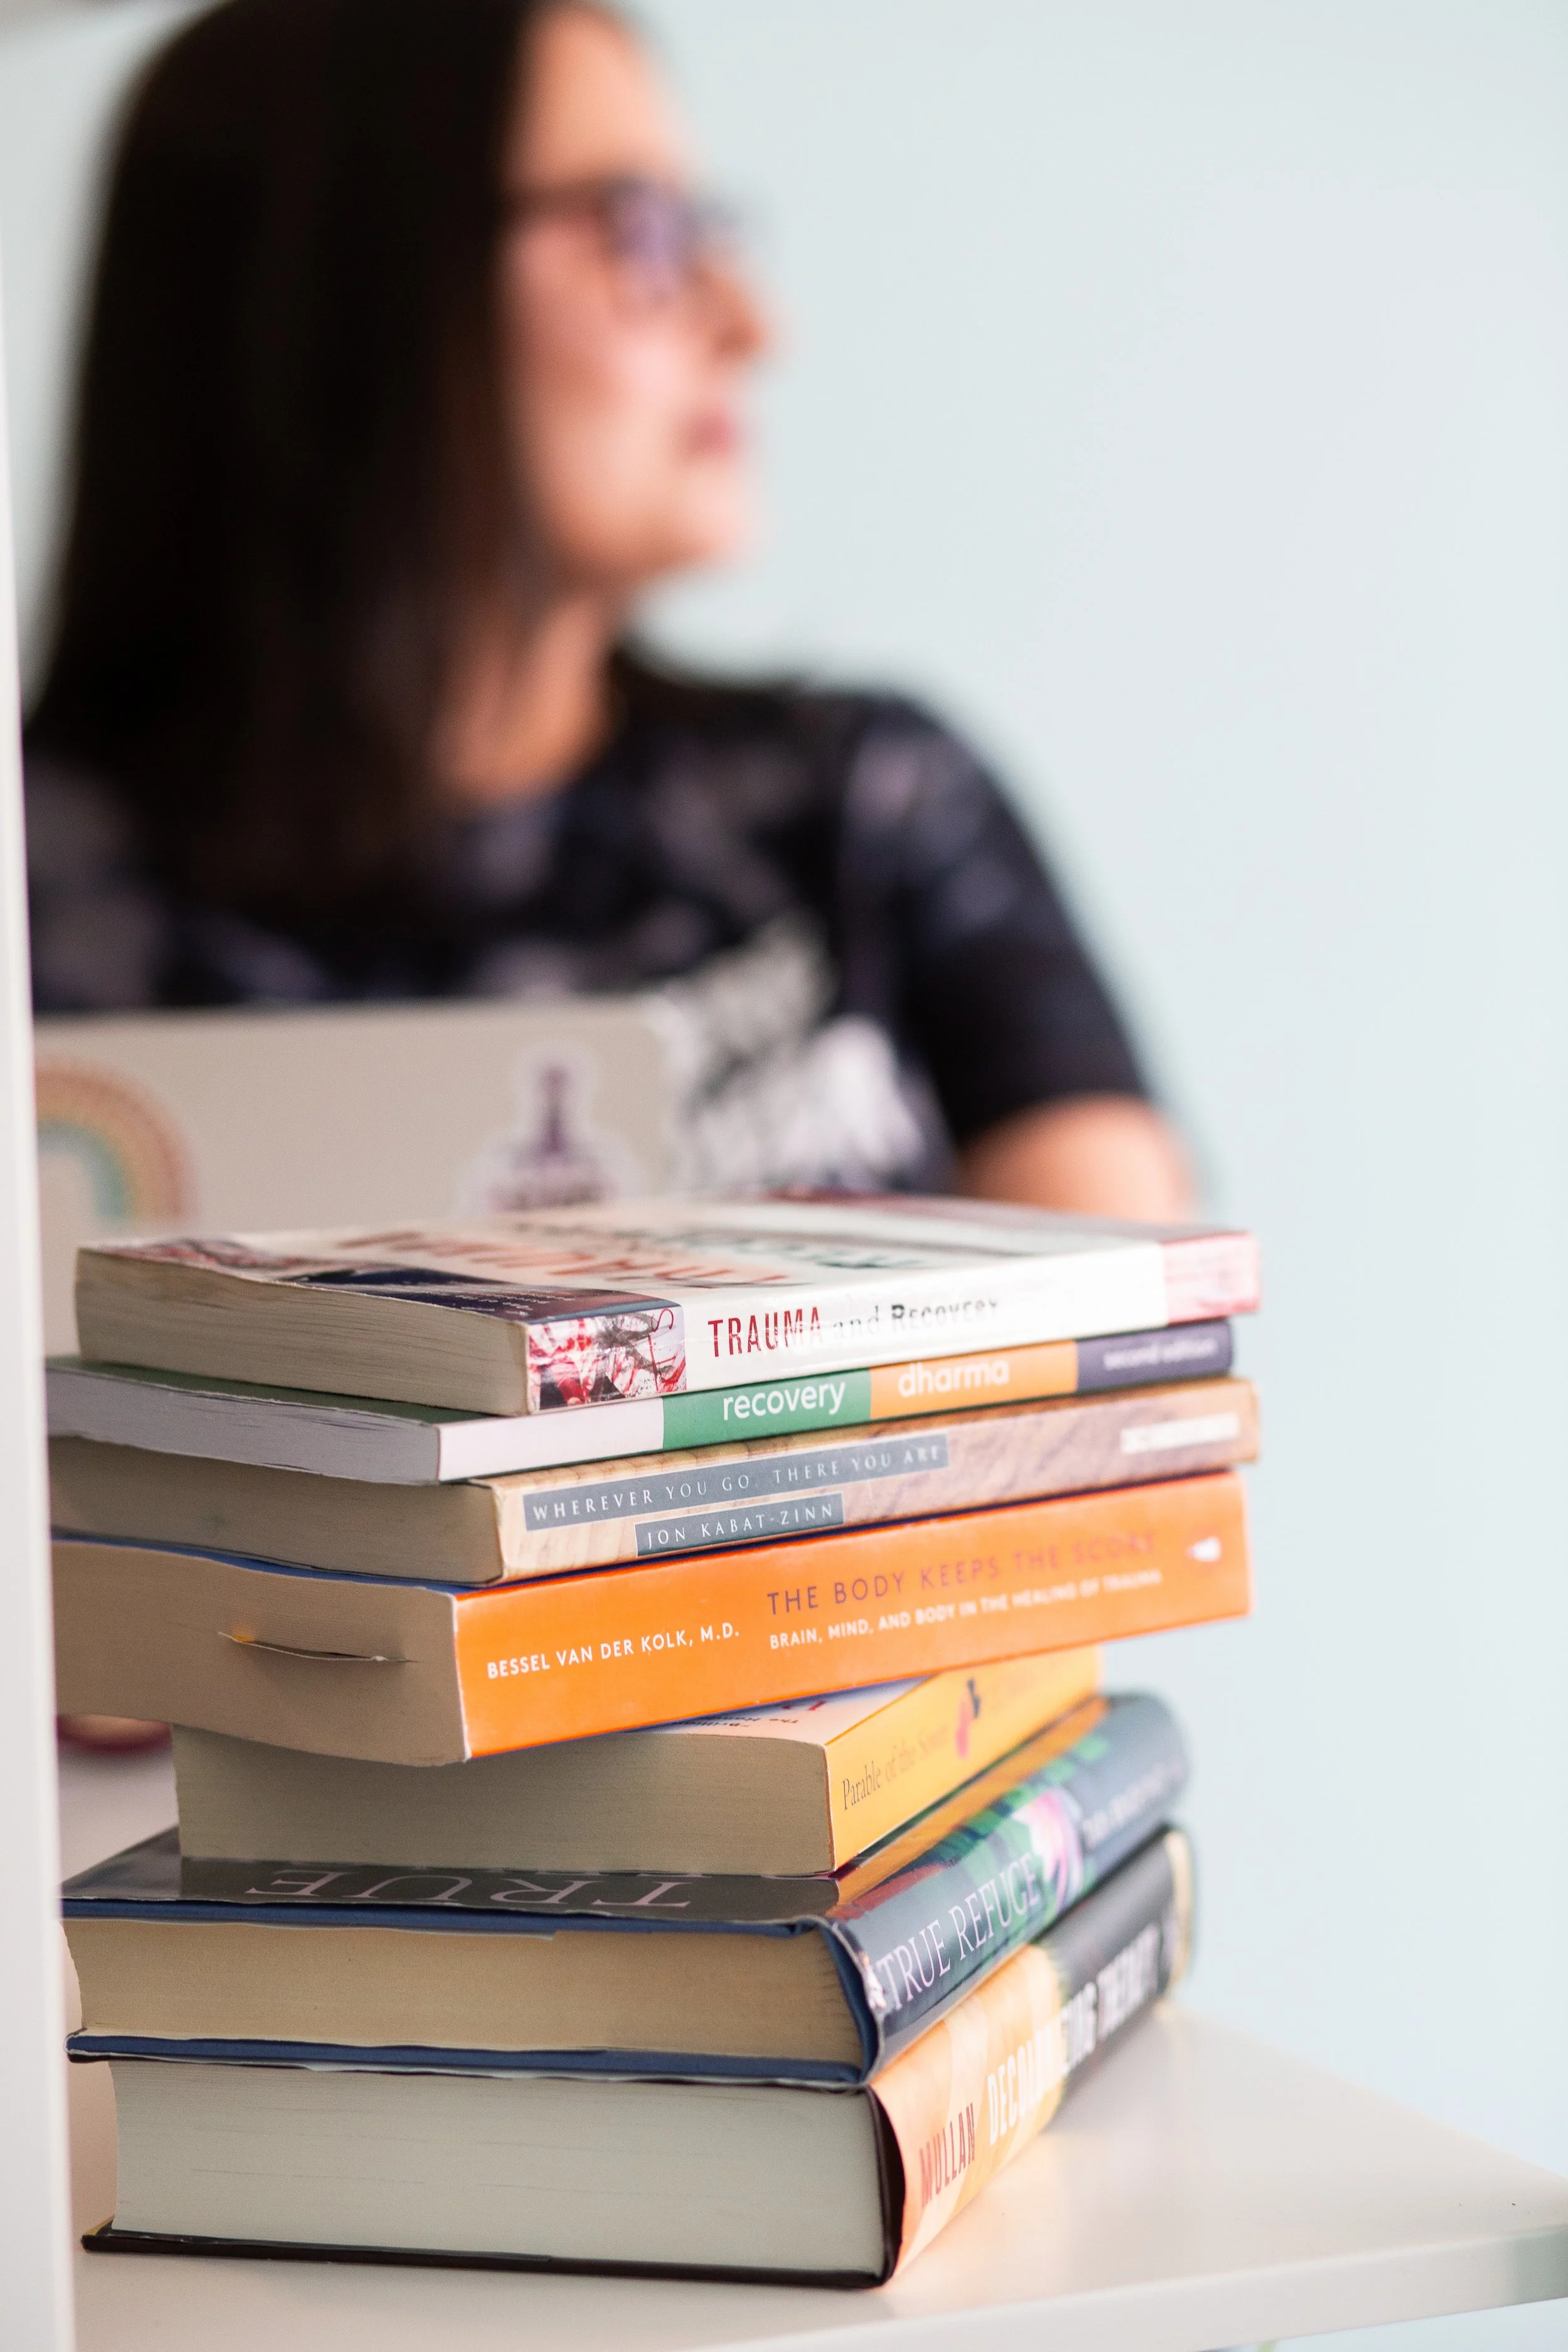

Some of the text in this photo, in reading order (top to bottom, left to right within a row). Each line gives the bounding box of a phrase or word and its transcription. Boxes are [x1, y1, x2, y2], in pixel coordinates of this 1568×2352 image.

[708, 1306, 824, 1357] TRAUMA
[832, 1305, 880, 1339] and
[723, 1361, 1010, 1421] recovery dharma
[533, 1490, 653, 1521] WHEREVER
[665, 1480, 707, 1500] YOU
[773, 1459, 839, 1484] THERE
[850, 1452, 891, 1471] YOU
[903, 1444, 940, 1465] ARE
[648, 1503, 833, 1550] JON KABAT-ZINN
[767, 1530, 1156, 1616] THE BODY KEEPS THE SCORE
[769, 1628, 823, 1650] BRAIN,
[828, 1618, 874, 1640] MIND,
[878, 1611, 911, 1631] AND
[914, 1603, 956, 1626] BODY
[958, 1599, 978, 1618] IN
[980, 1593, 1009, 1614] THE
[487, 1622, 740, 1680] BESSEL VAN DER KOLK, M.D.
[842, 1759, 881, 1811] Parable
[244, 1868, 691, 1908] TRUE
[875, 1851, 1041, 2011] TRUE REFUGE
[918, 2102, 977, 2210] MULLAN
